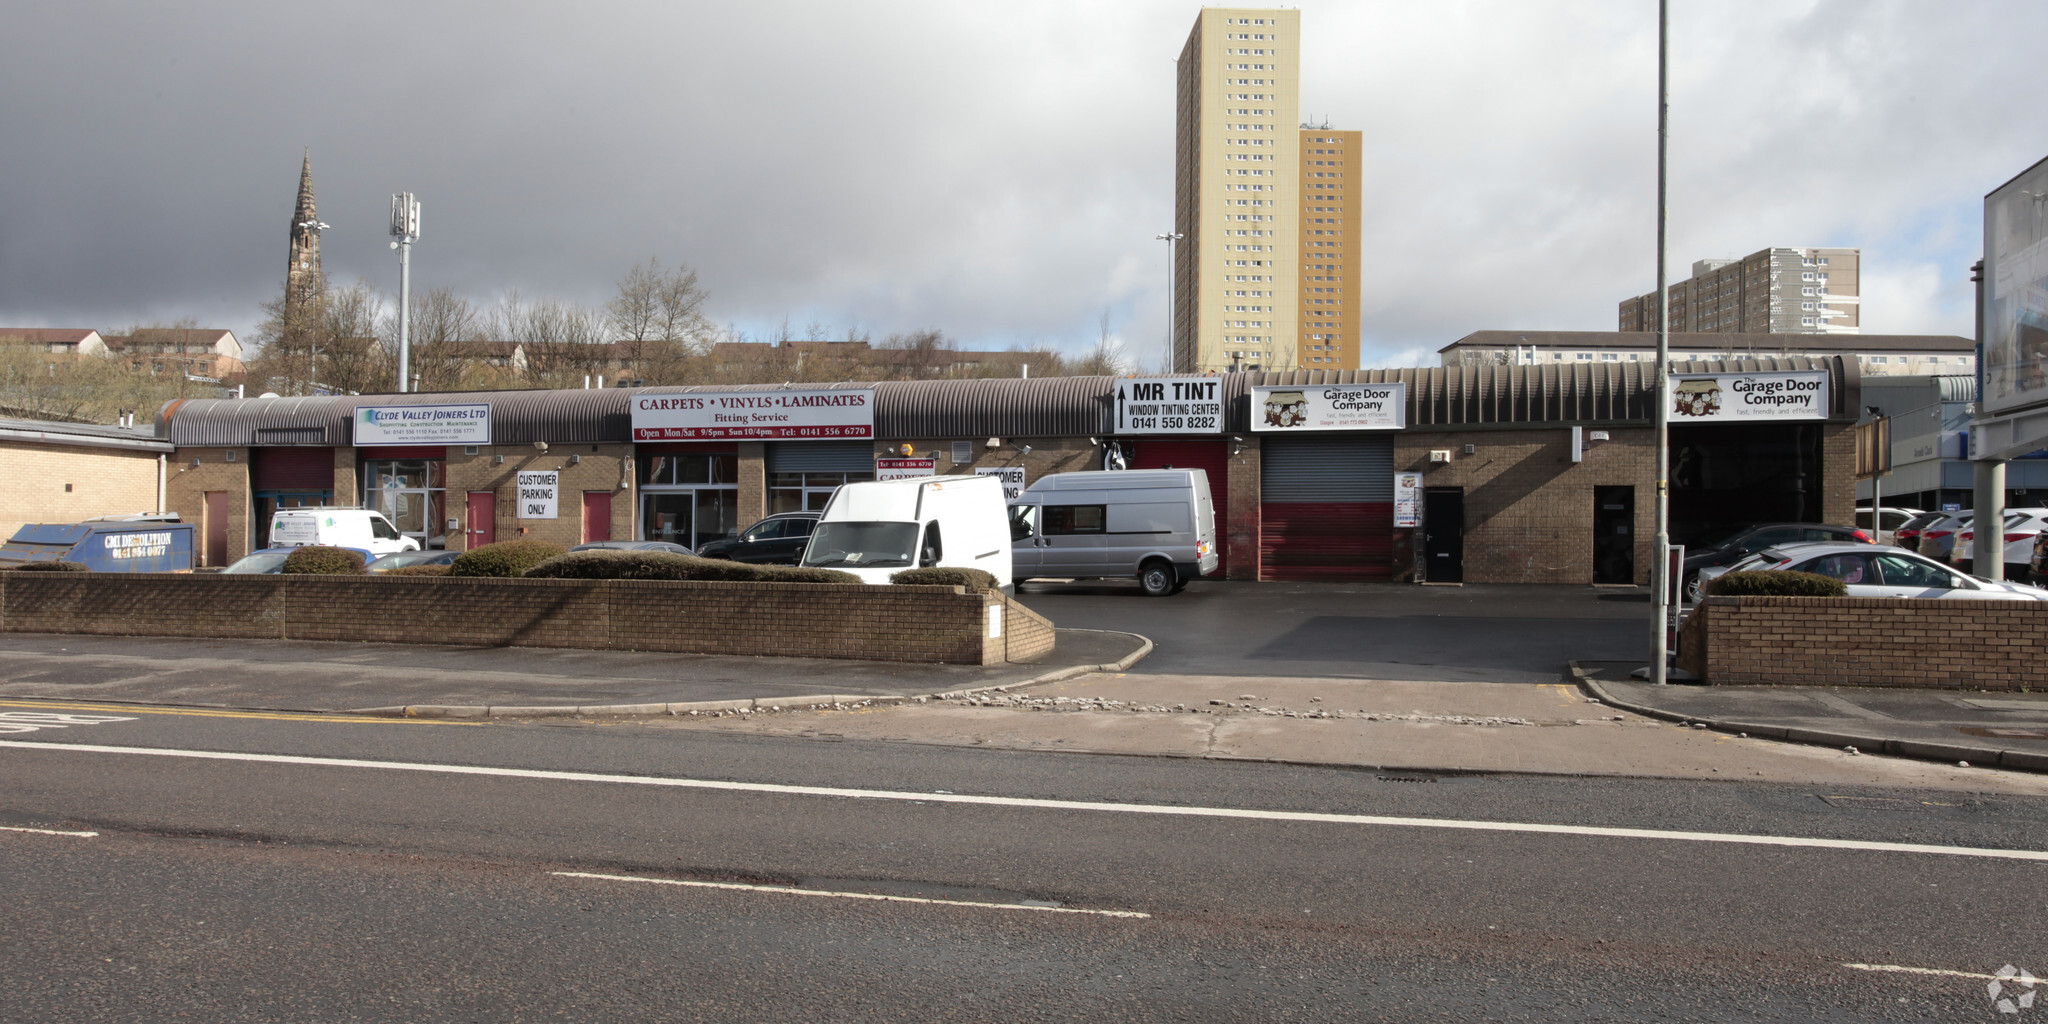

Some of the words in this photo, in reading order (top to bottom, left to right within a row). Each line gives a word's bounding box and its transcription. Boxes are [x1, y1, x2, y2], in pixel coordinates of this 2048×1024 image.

[1133, 383, 1165, 401] MR
[1172, 382, 1217, 400] TINT
[1732, 380, 1783, 395] Garage
[1786, 379, 1822, 391] Door
[1323, 389, 1362, 402] Garage
[1363, 389, 1391, 398] Door
[1744, 392, 1811, 407] Company
[640, 398, 704, 410] CARPETS
[720, 397, 772, 408] VINYLS
[781, 395, 865, 407] LAMINATES
[1332, 400, 1383, 412] Company
[375, 410, 399, 420] CLYDE
[402, 410, 432, 420] VALLEY
[432, 410, 468, 421] JOINERS
[470, 409, 486, 418] LTD
[1129, 404, 1159, 415] WINDOW
[1162, 404, 1189, 415] TINTING
[1192, 404, 1220, 415] CENTER
[714, 413, 748, 424] Fitting
[751, 413, 789, 422] Service
[1132, 417, 1157, 429] 0141
[1161, 417, 1183, 429] 550
[1187, 416, 1215, 428] 8282
[640, 428, 660, 439] Open
[664, 428, 695, 438] Mon/Sat
[700, 428, 724, 437] 9/5pm
[728, 428, 743, 436] Sun
[744, 427, 773, 437] 10/4pm
[780, 428, 797, 437] Tel:
[800, 428, 820, 436] 0141
[825, 427, 840, 435] 556
[844, 427, 865, 435] 6770
[518, 475, 557, 485] CUSTOMER
[522, 489, 553, 499] PARKING
[528, 504, 546, 515] ONLY
